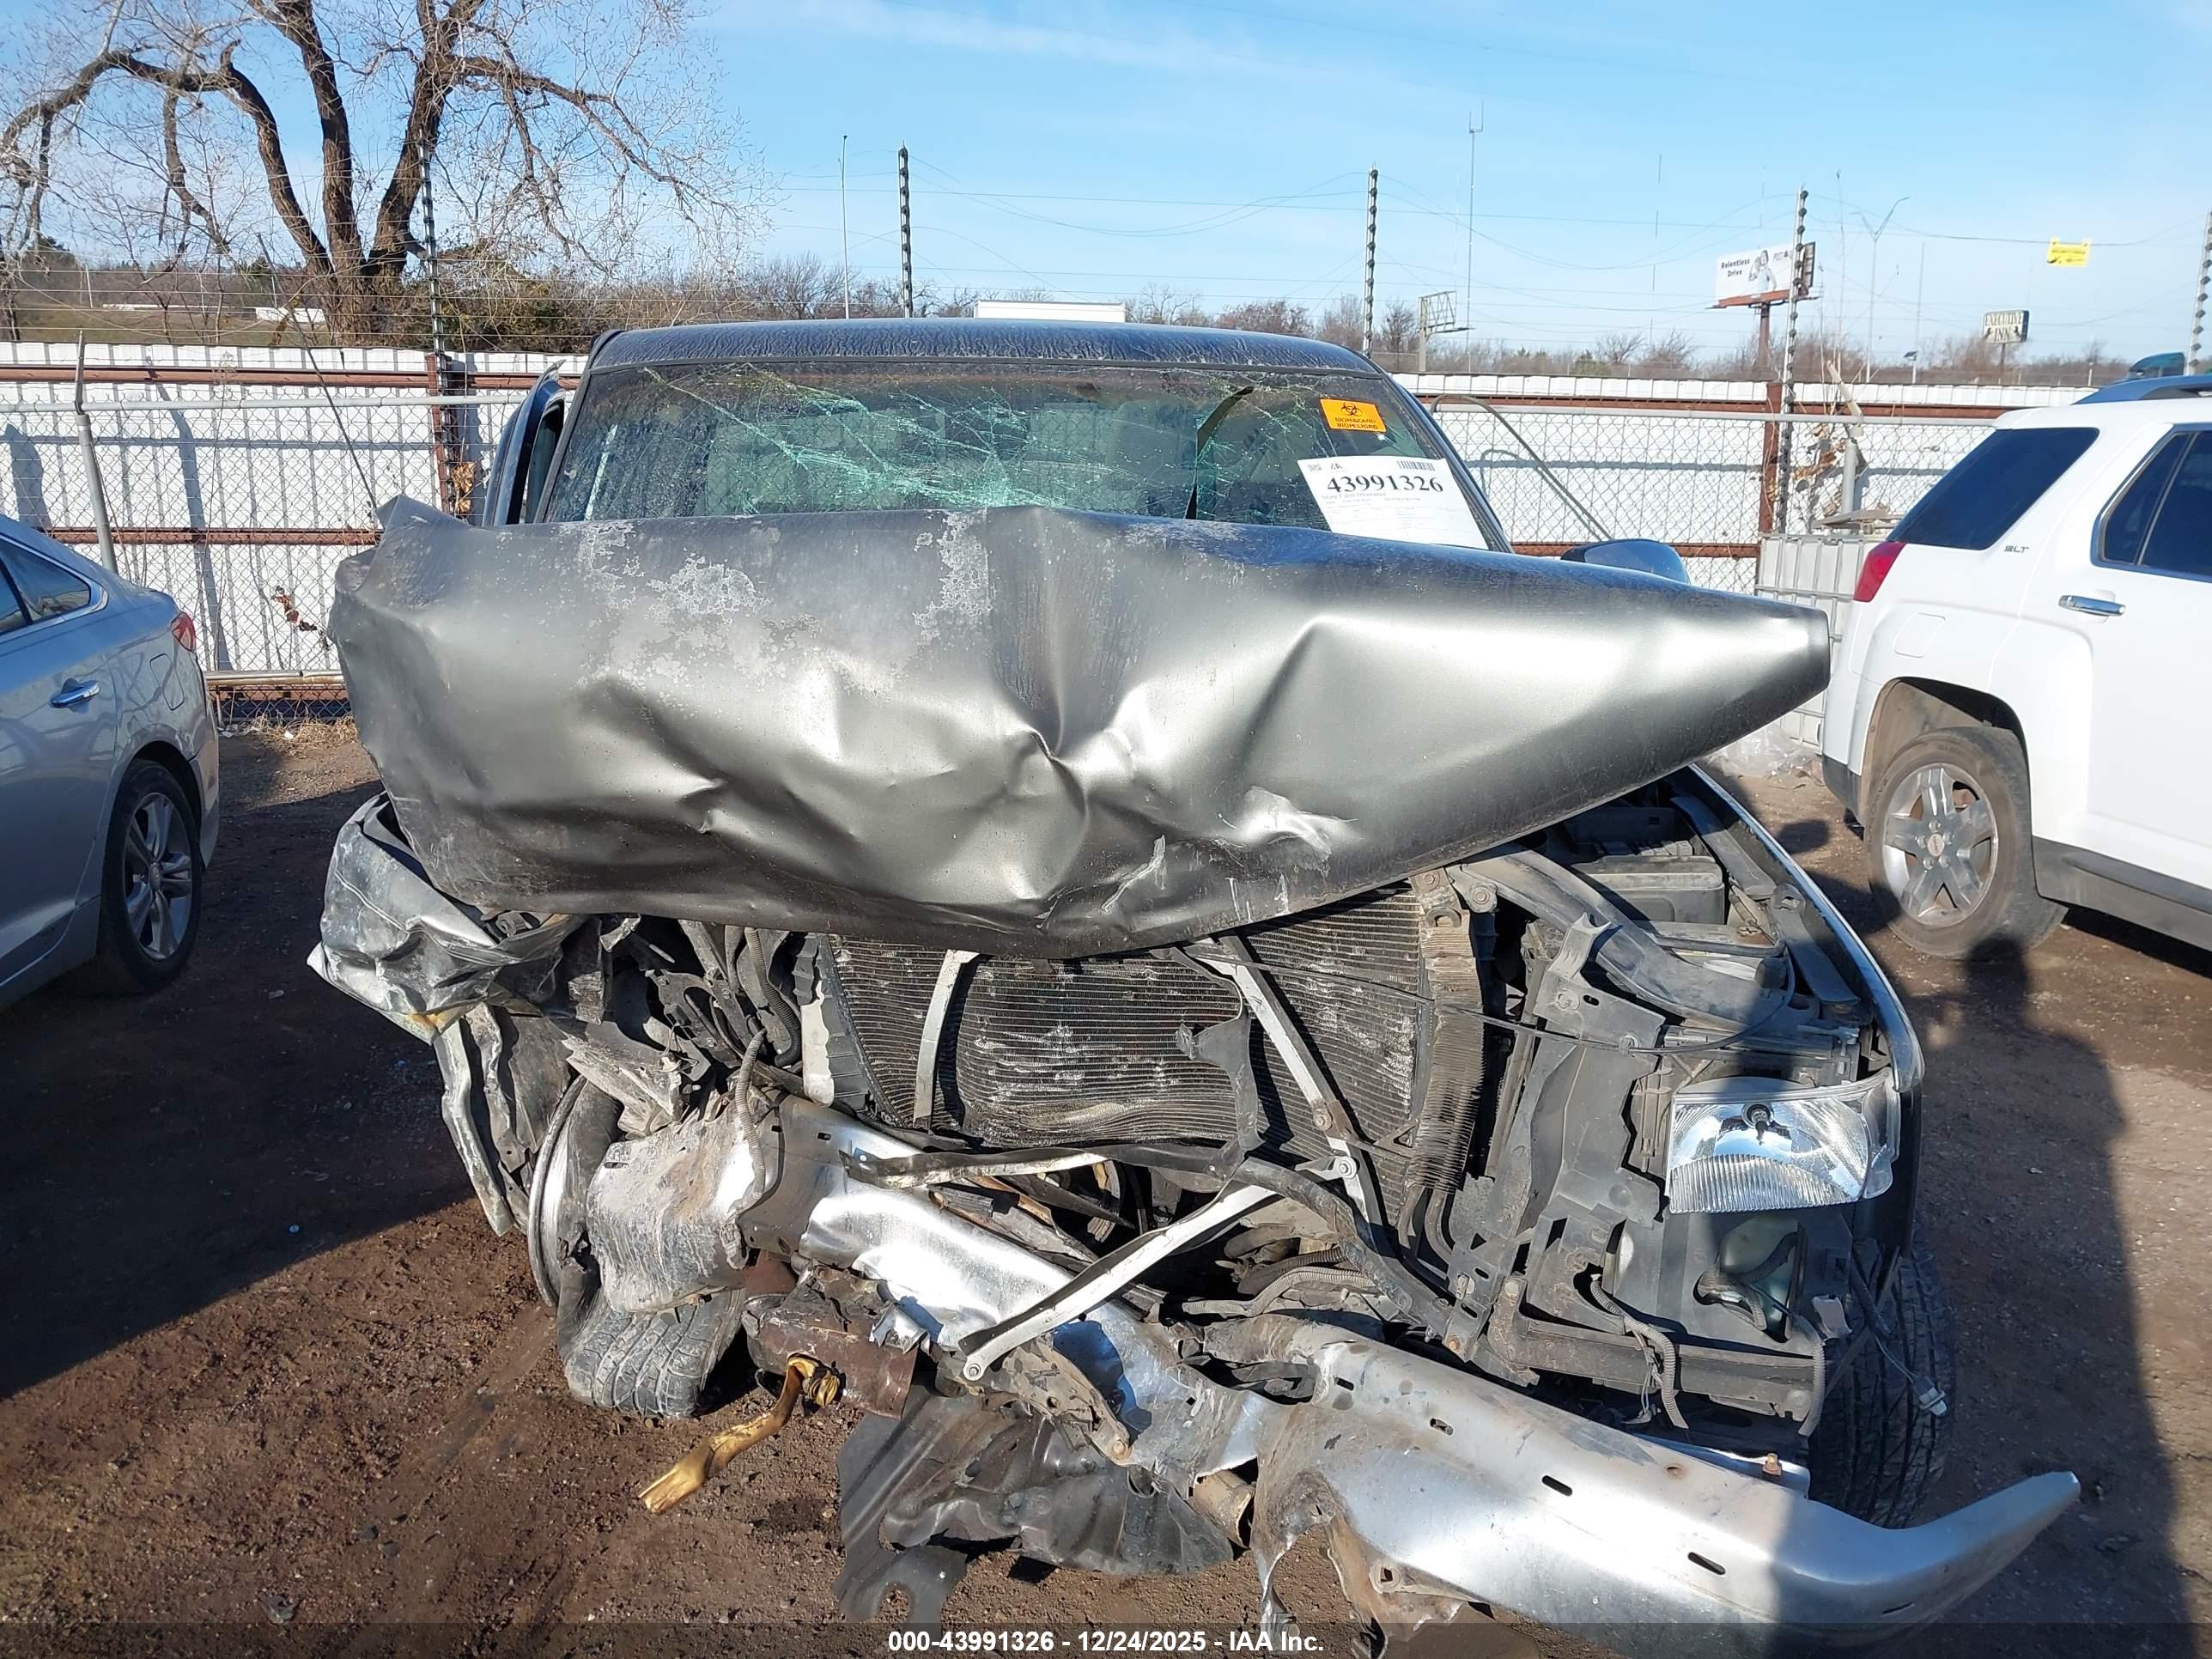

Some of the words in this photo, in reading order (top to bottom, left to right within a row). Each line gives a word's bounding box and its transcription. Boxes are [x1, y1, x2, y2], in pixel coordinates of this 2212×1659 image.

[1721, 258, 1750, 269] Relentless
[1985, 313, 2021, 326] EXECUTIVE
[1995, 328, 2011, 341] INN
[1328, 475, 1443, 493] 43991326
